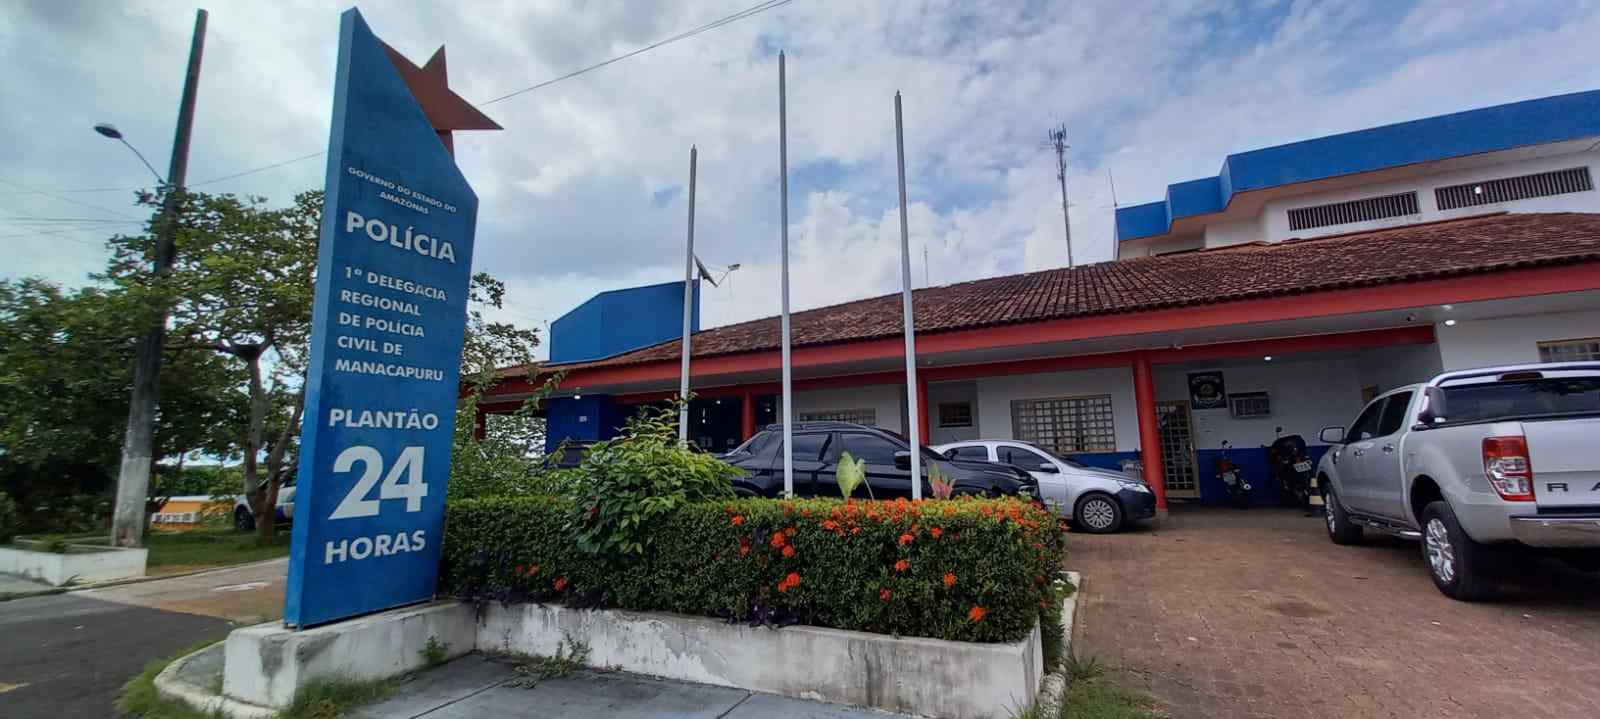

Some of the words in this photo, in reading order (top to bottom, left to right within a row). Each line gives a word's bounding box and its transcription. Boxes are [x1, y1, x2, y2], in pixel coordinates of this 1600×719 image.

[349, 167, 396, 190] GOVERNO
[398, 184, 411, 195] DO
[413, 191, 443, 208] ESTADO
[445, 203, 457, 213] DO
[380, 191, 429, 215] AMAZONAS
[346, 211, 457, 264] POLÍCIA
[367, 271, 447, 301] DELEGACIA
[341, 289, 421, 316] REGIONAL
[339, 312, 360, 327] DE
[366, 317, 425, 338] POLÍCIA
[337, 335, 378, 353] CIVIL
[383, 342, 403, 356] DE
[335, 358, 444, 381] MANACAPURU
[328, 408, 439, 430] PLANTÃO
[328, 446, 429, 521] 24
[324, 529, 426, 565] HORAS
